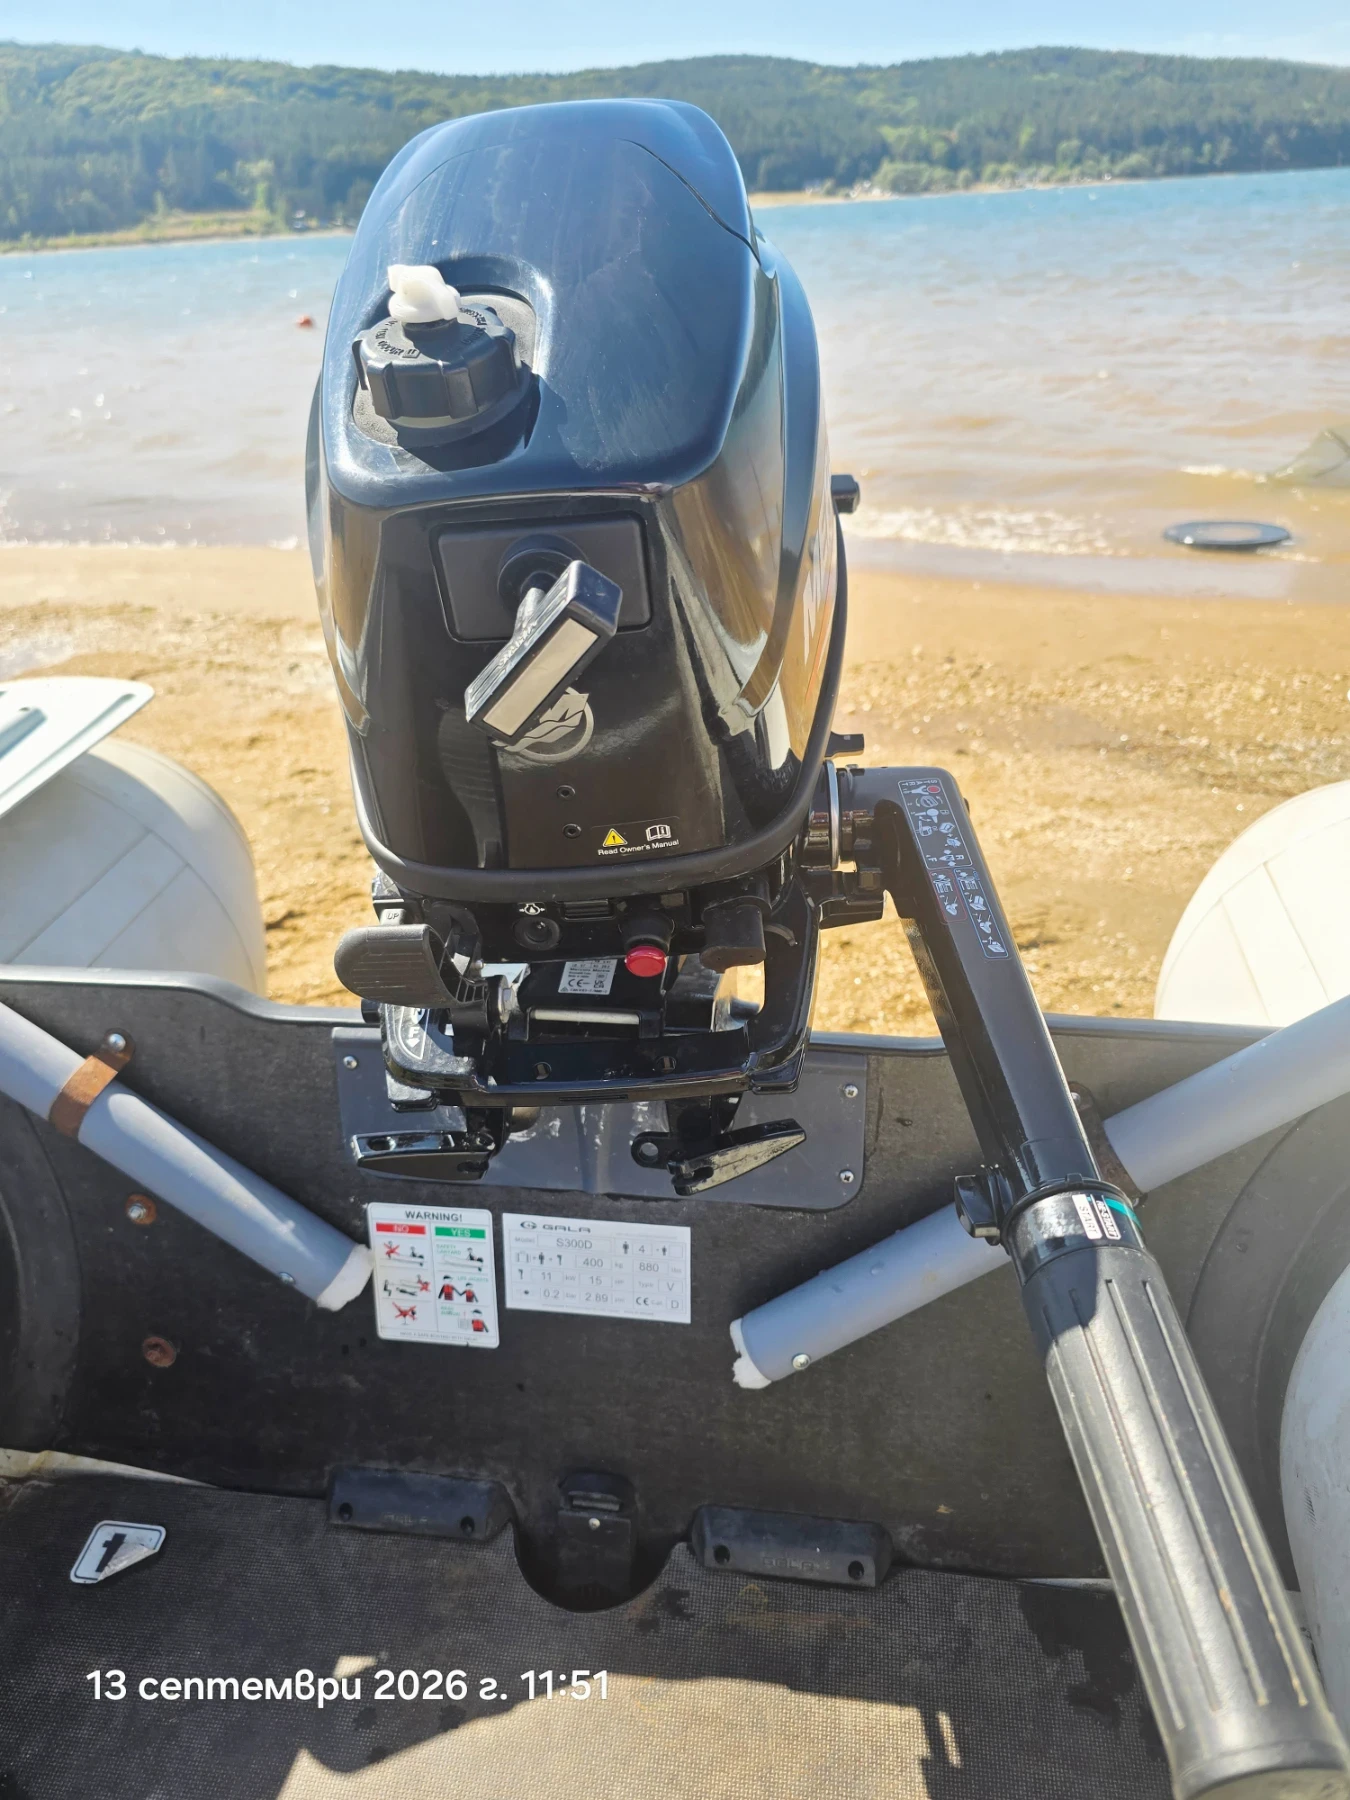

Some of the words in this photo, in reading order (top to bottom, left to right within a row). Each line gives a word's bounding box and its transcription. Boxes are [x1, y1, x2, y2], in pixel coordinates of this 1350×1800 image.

[597, 848, 618, 856] Read
[619, 843, 651, 853] Owner's
[652, 839, 680, 849] Manual
[408, 1026, 420, 1038] F
[404, 1209, 463, 1222] WARNING!
[1078, 1206, 1098, 1235] START
[393, 1225, 409, 1234] NO
[450, 1228, 472, 1238] YES
[542, 1223, 592, 1234] GALA
[556, 1237, 593, 1250] S300D
[638, 1244, 646, 1254] 4
[582, 1257, 604, 1268] 400
[639, 1261, 660, 1273] 880
[541, 1271, 552, 1281] 11
[589, 1275, 603, 1286] 15
[666, 1281, 675, 1292] V
[543, 1288, 560, 1300] 0.2
[585, 1292, 609, 1303] 2.89
[670, 1300, 679, 1309] D
